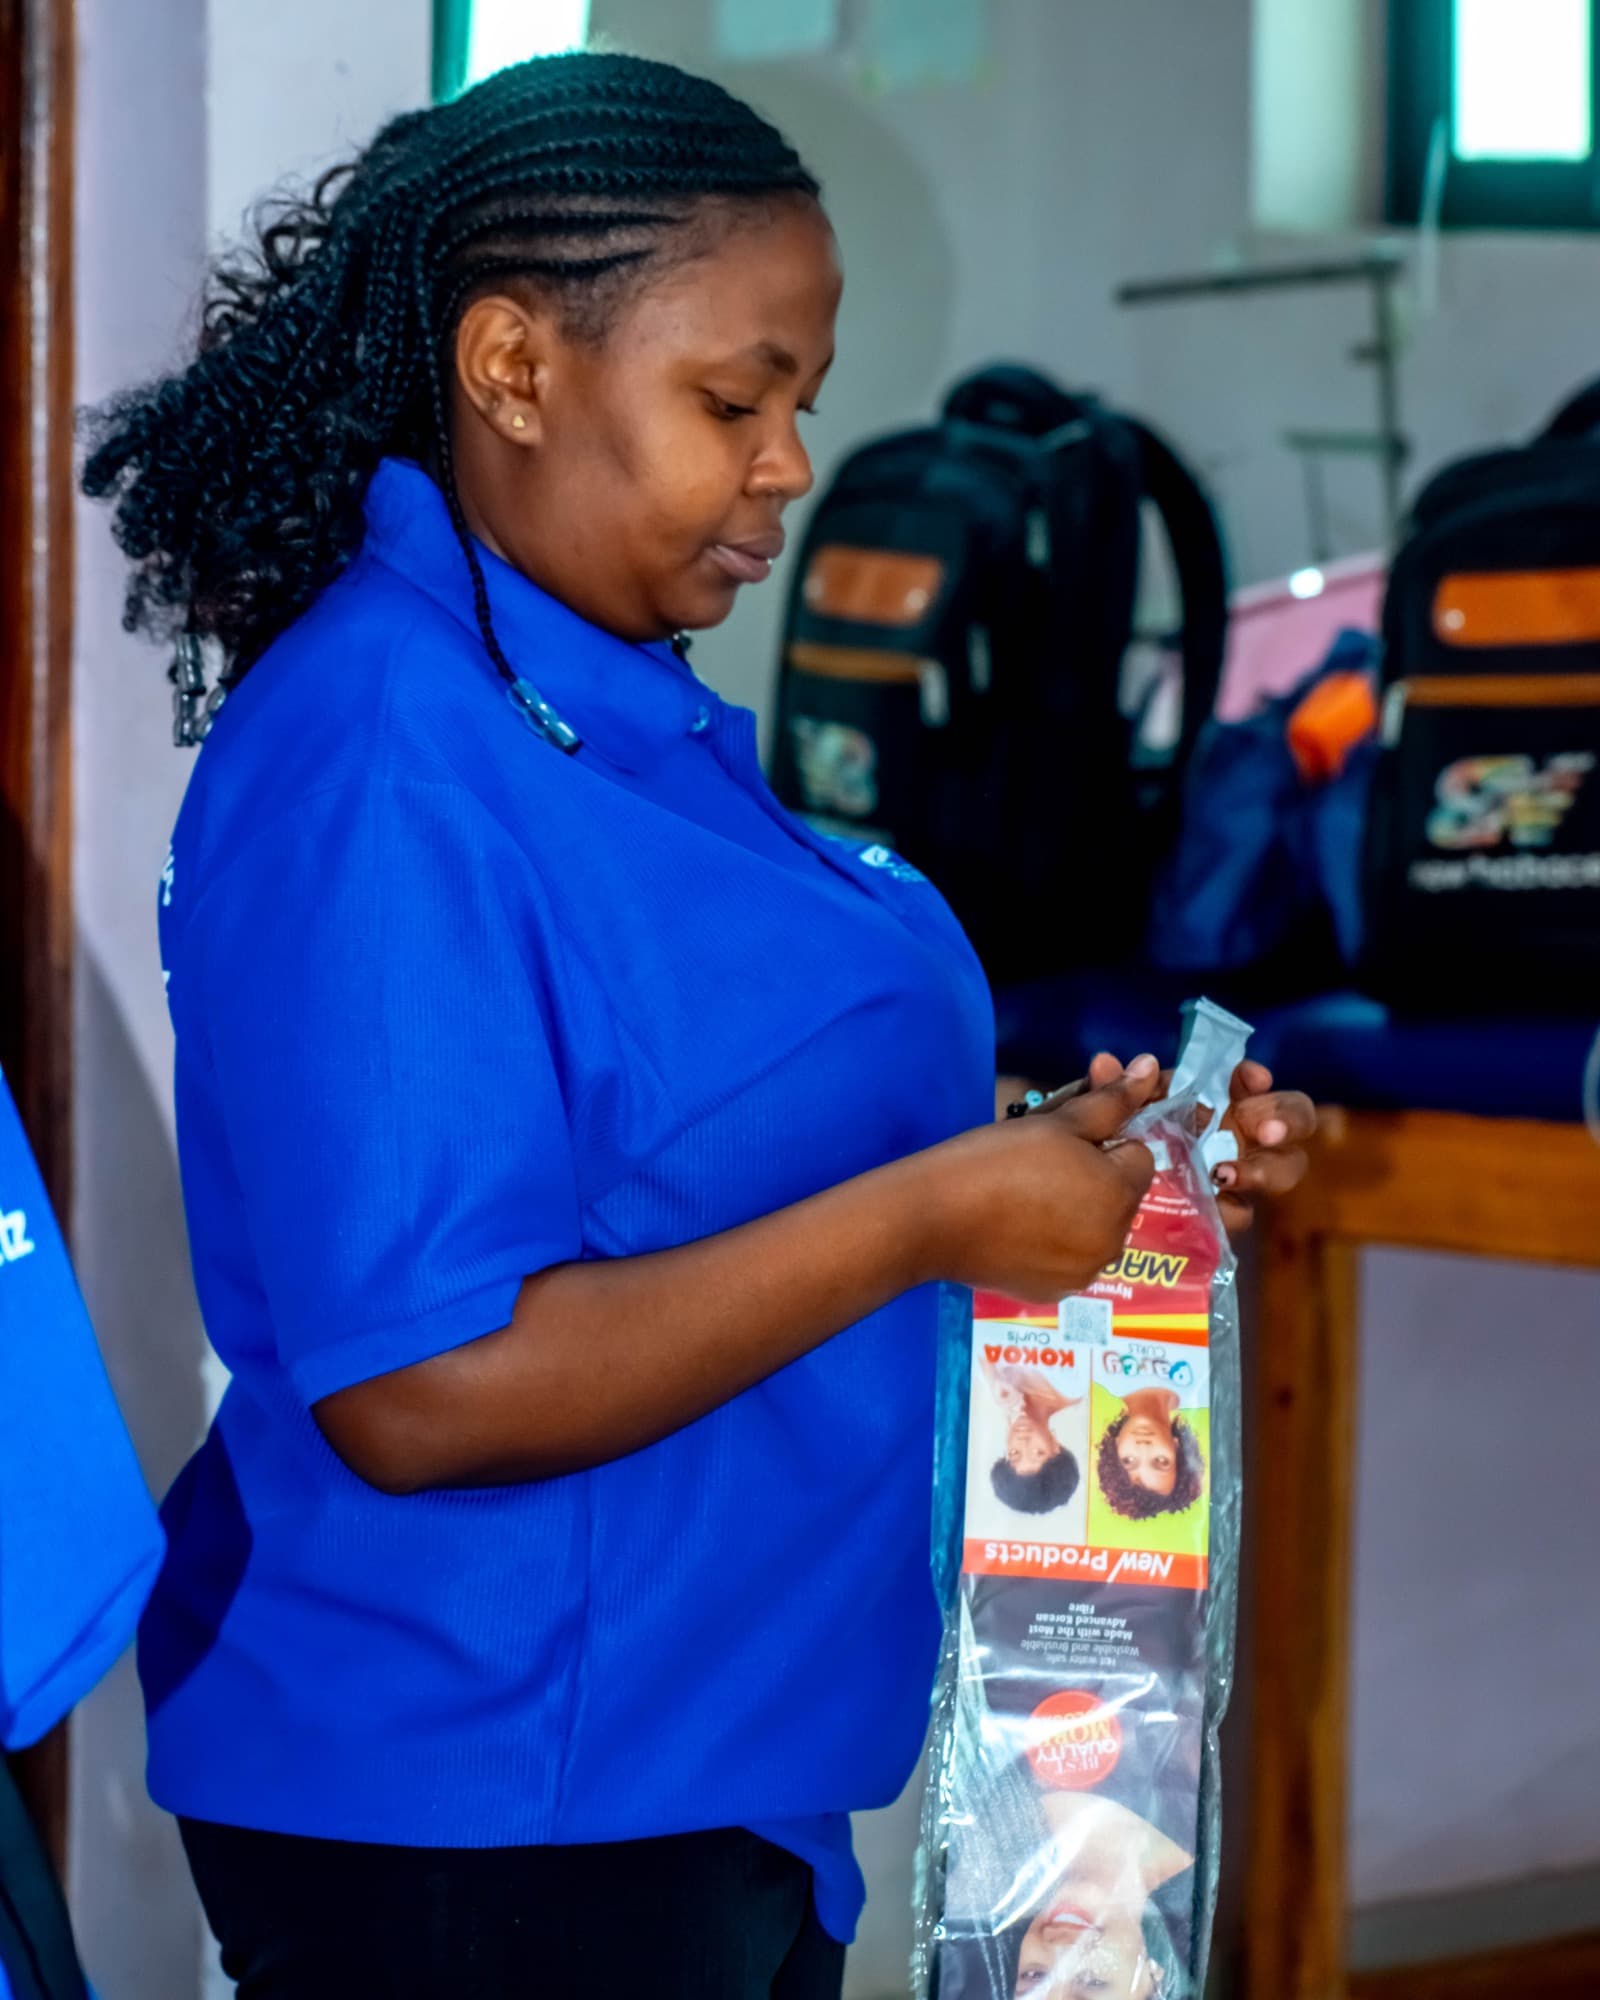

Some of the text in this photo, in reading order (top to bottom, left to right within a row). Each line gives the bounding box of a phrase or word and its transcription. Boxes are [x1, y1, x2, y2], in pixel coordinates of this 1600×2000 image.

[1007, 1331, 1050, 1345] Curls
[983, 1344, 1074, 1367] KOKOA
[1127, 1343, 1166, 1359] CURLS
[984, 1542, 1107, 1571] Products
[1068, 1603, 1094, 1614] Fibre
[1035, 1613, 1126, 1628] Advanced Korean
[1028, 1624, 1132, 1640] Made with the Most
[1020, 1639, 1139, 1656] Washable and Brushable
[1036, 1738, 1117, 1763] QUALITY
